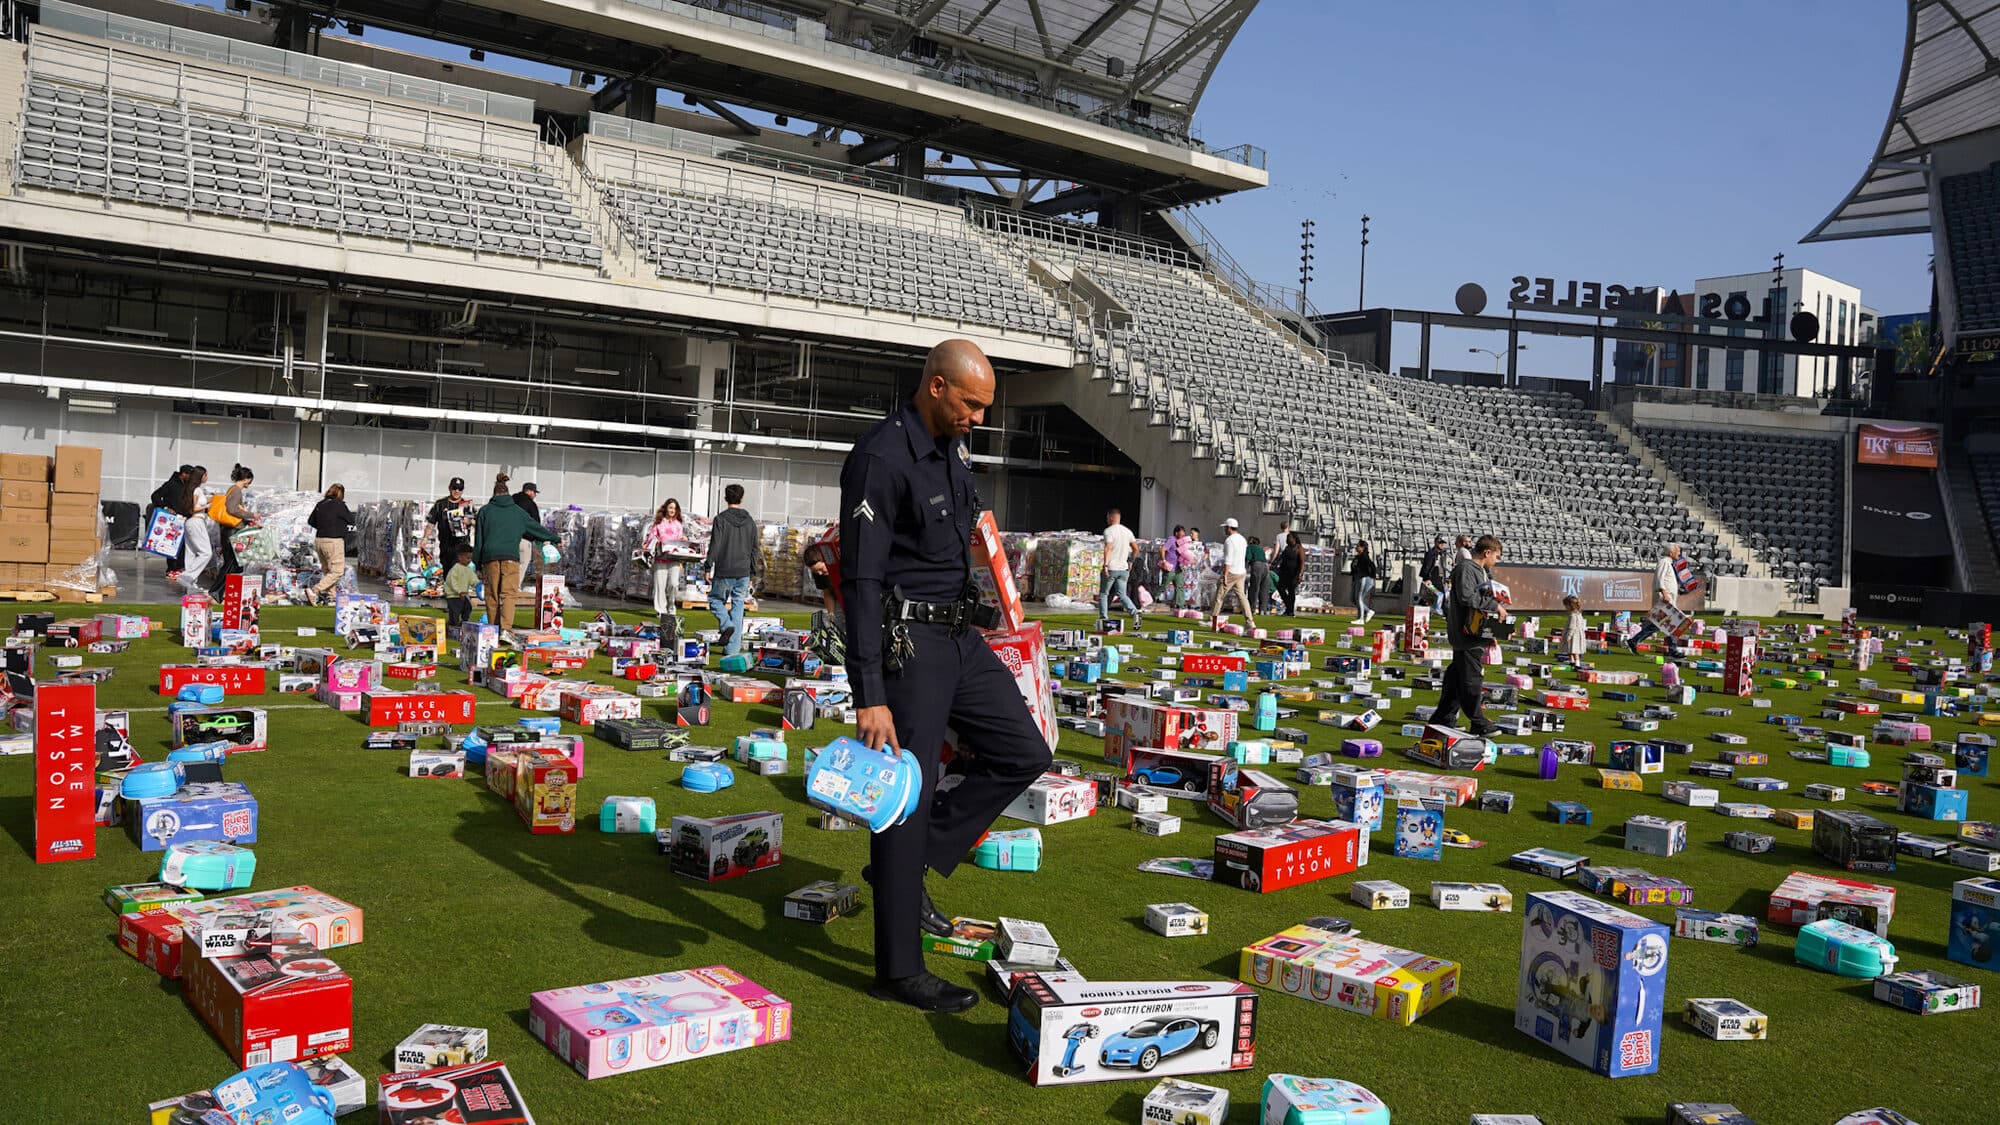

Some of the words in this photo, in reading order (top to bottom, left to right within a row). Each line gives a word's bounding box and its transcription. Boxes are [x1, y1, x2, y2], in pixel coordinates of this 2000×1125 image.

[1863, 436, 1891, 454] TKF
[1862, 505, 1901, 516] BMO
[1561, 575, 1585, 597] TKF
[1869, 593, 1886, 601] BMO
[225, 584, 235, 626] TYSON
[191, 673, 251, 681] TYSON
[394, 701, 435, 709] MIKE
[384, 711, 445, 720] TYSON
[49, 708, 65, 810] TYSON
[69, 724, 84, 791] MIKE
[224, 813, 249, 825] Band
[224, 824, 250, 836] Kid's
[50, 839, 83, 850] ALL-STAR
[1286, 845, 1323, 863] MIKE
[1275, 858, 1332, 880] TYSON
[205, 933, 237, 942] STAR
[204, 940, 236, 948] WARS
[933, 941, 979, 958] SUBWAY
[1606, 933, 1617, 969] Kid's
[1103, 1005, 1139, 1016] BUGATTI
[1140, 1003, 1173, 1014] CHIRON
[398, 1050, 425, 1059] STAR
[1621, 1034, 1633, 1067] Kid's
[1633, 1032, 1644, 1065] Band
[399, 1056, 425, 1065] WARS
[1146, 1105, 1174, 1115] STAR
[1146, 1111, 1174, 1122] WARS
